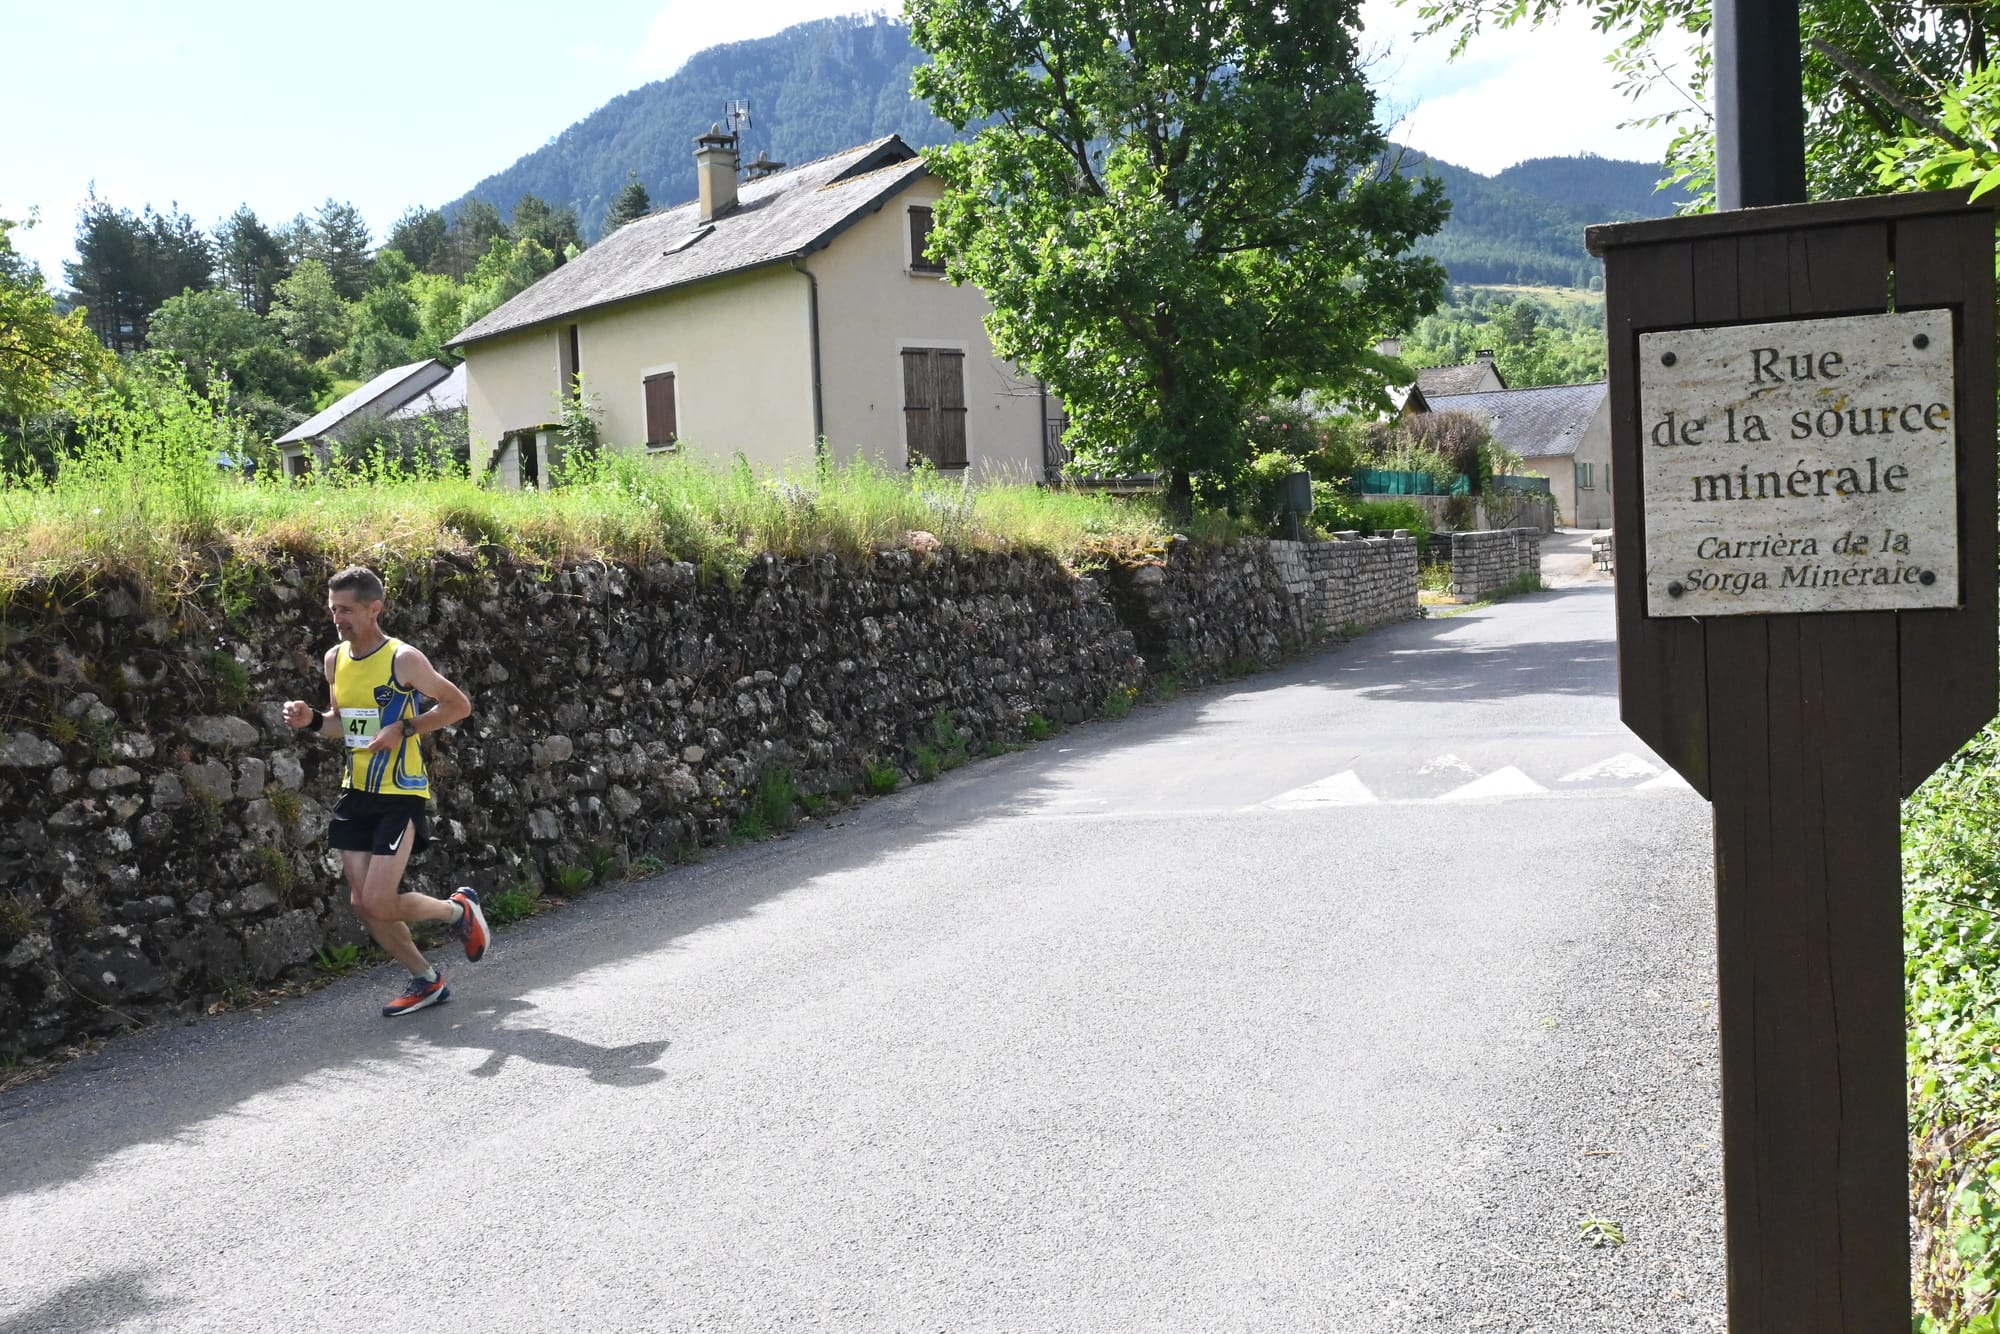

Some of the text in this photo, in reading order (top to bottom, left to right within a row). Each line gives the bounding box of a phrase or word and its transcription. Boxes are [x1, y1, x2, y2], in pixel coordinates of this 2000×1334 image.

[1749, 347, 1844, 385] Rue
[1651, 402, 1950, 447] de la source
[1692, 458, 1909, 502] minérale
[1697, 529, 1911, 560] Carrièra de la
[1684, 568, 1768, 594] Sorga
[349, 719, 367, 734] 47
